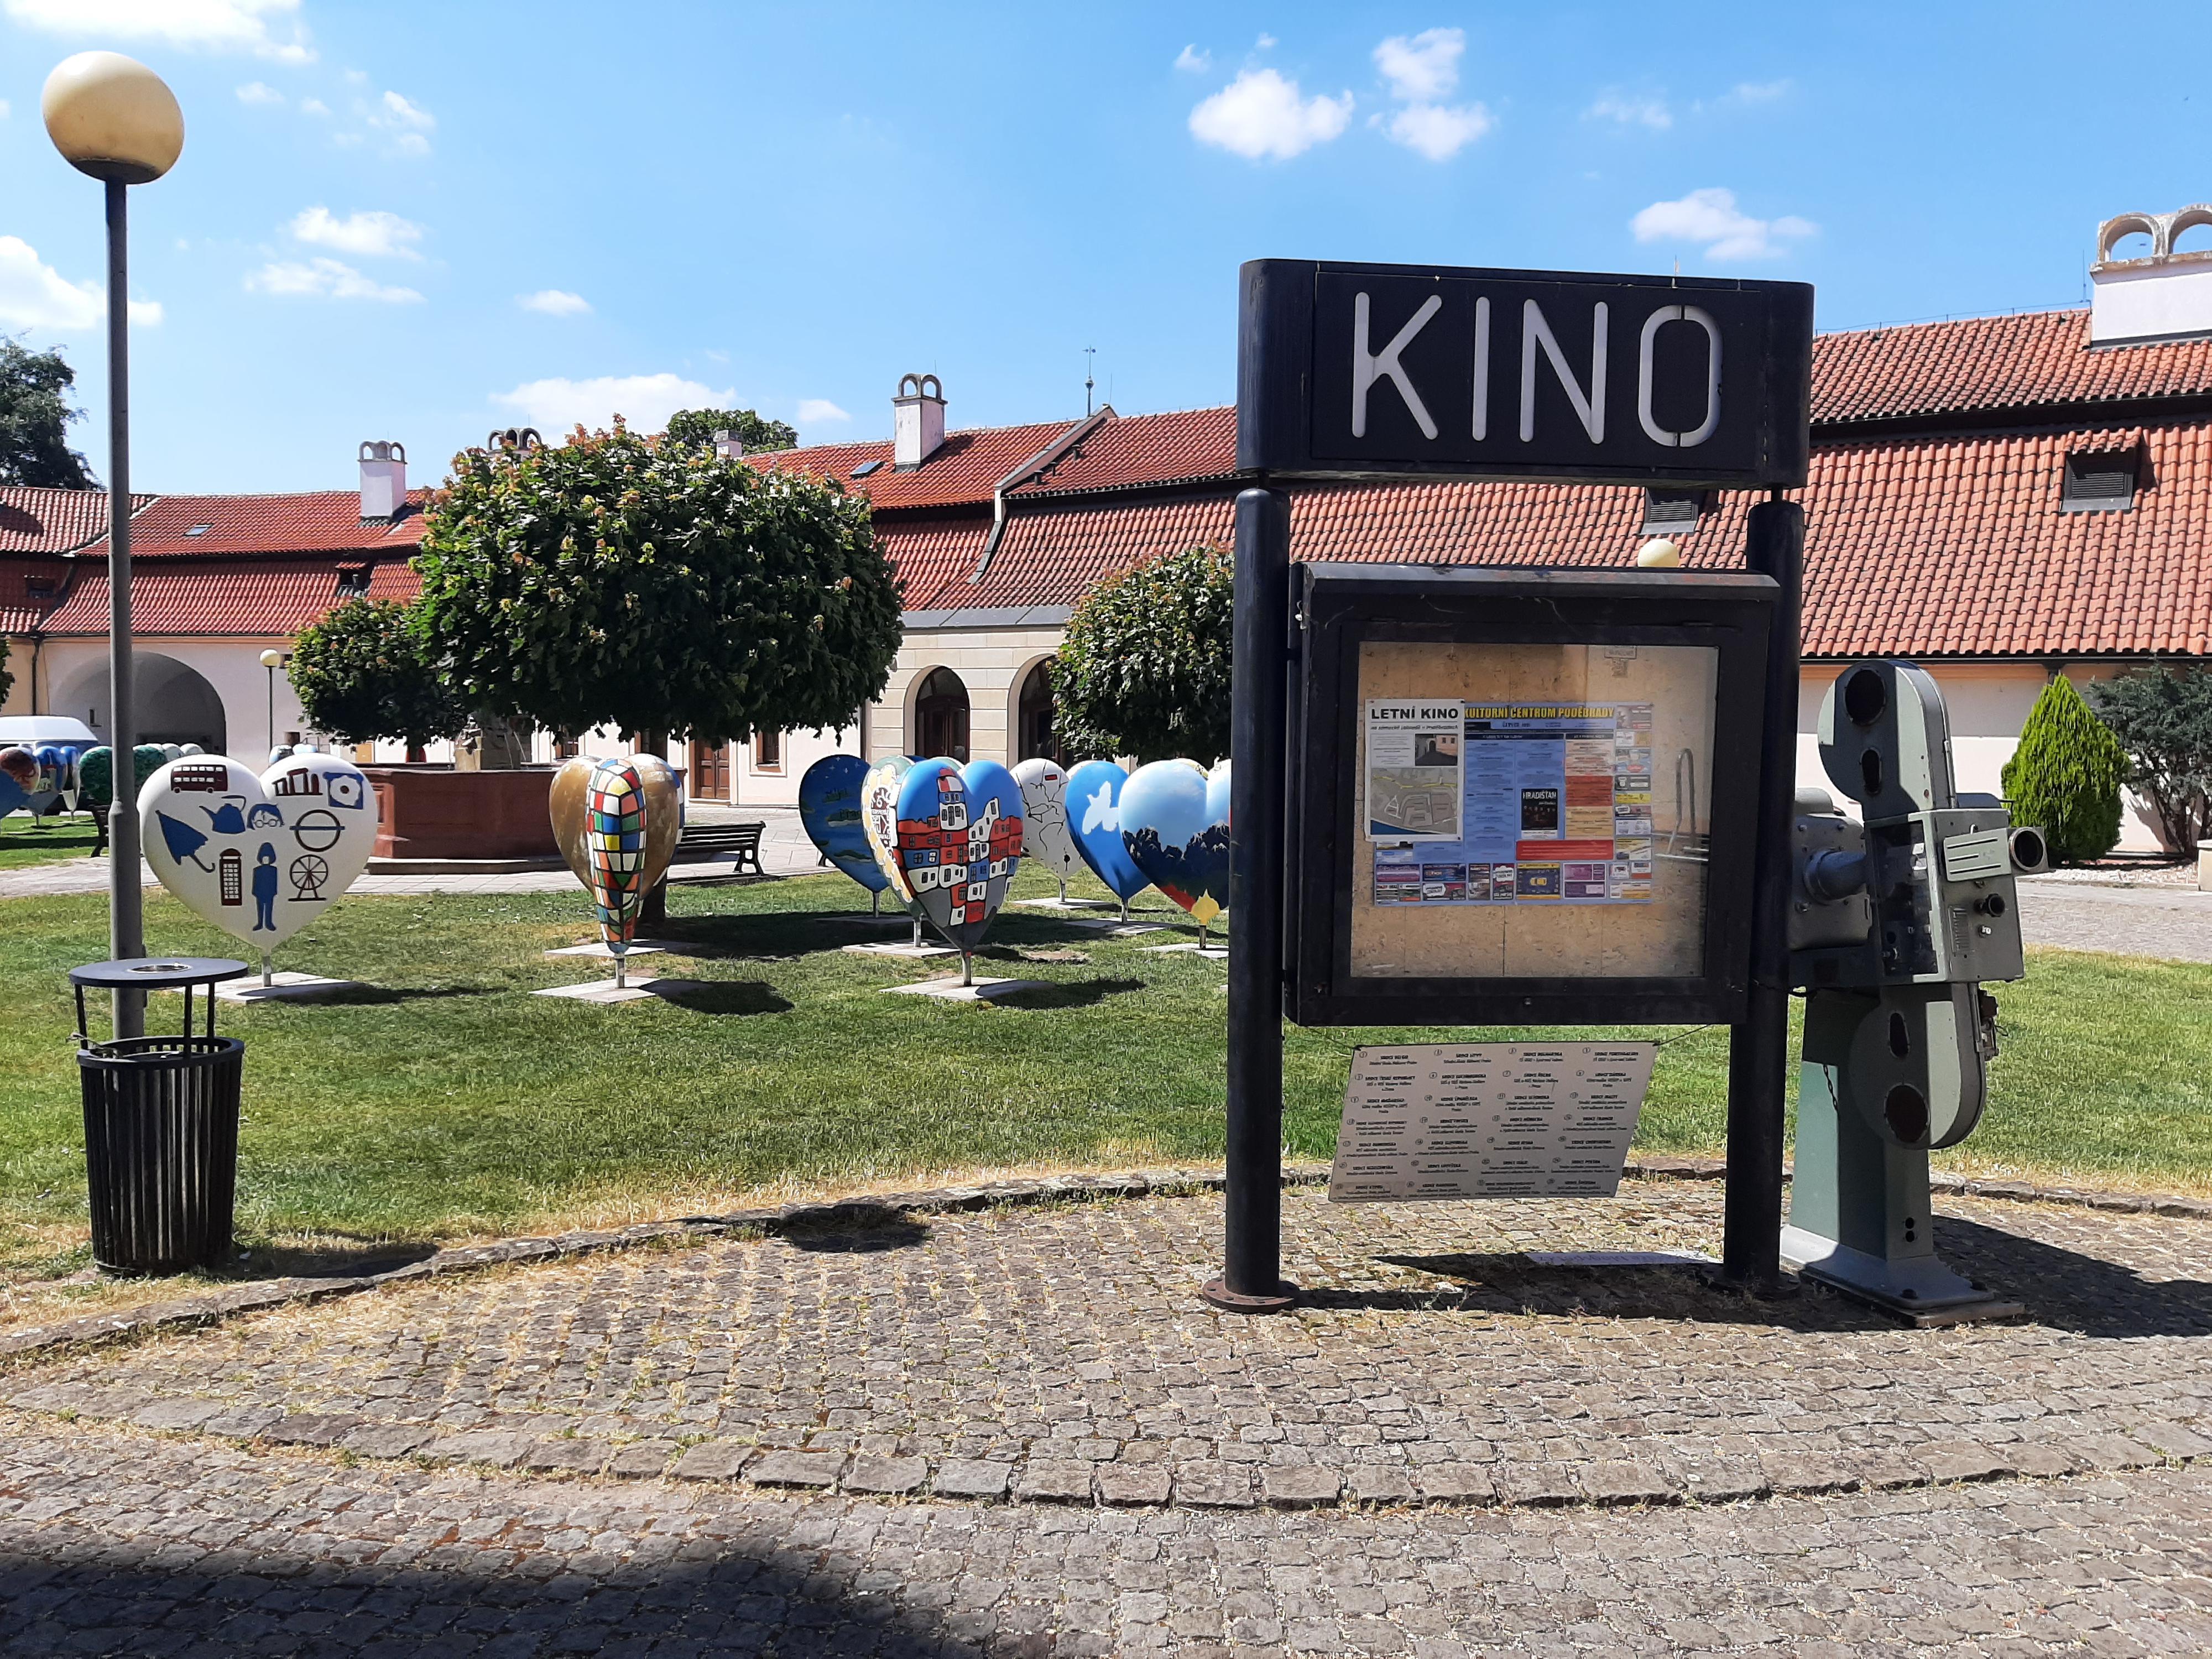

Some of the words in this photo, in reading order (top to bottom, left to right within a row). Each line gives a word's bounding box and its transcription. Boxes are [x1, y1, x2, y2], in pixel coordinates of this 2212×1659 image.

[1352, 291, 1723, 447] KINO
[1371, 706, 1415, 719] LETNÍ
[1421, 708, 1458, 719] KINO
[1510, 707, 1556, 718] CENTRUM
